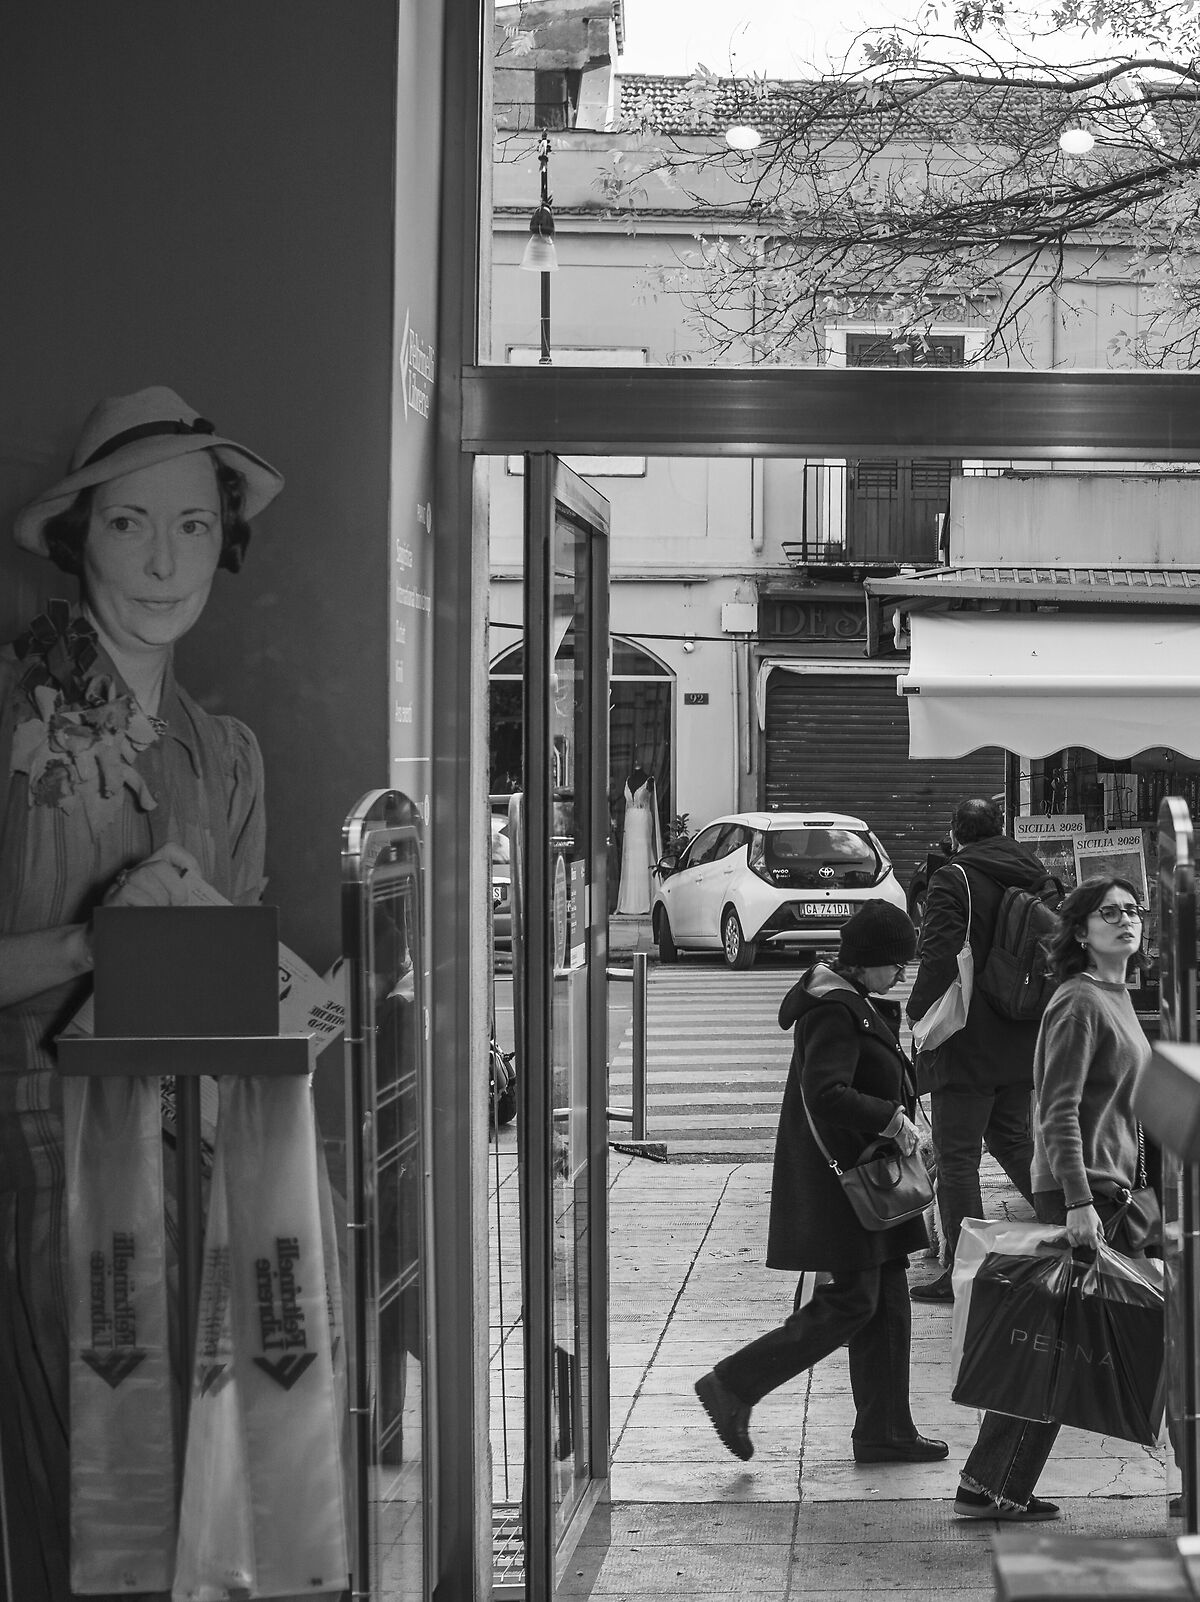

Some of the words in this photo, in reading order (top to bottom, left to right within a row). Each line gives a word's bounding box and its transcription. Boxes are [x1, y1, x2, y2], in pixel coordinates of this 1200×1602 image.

[770, 602, 828, 637] DE
[689, 693, 704, 704] 92
[1018, 823, 1057, 834] SICILIA
[1060, 822, 1083, 832] 2026
[1076, 837, 1114, 850] SICILIA
[1117, 835, 1140, 846] 2026
[805, 904, 817, 913] GA
